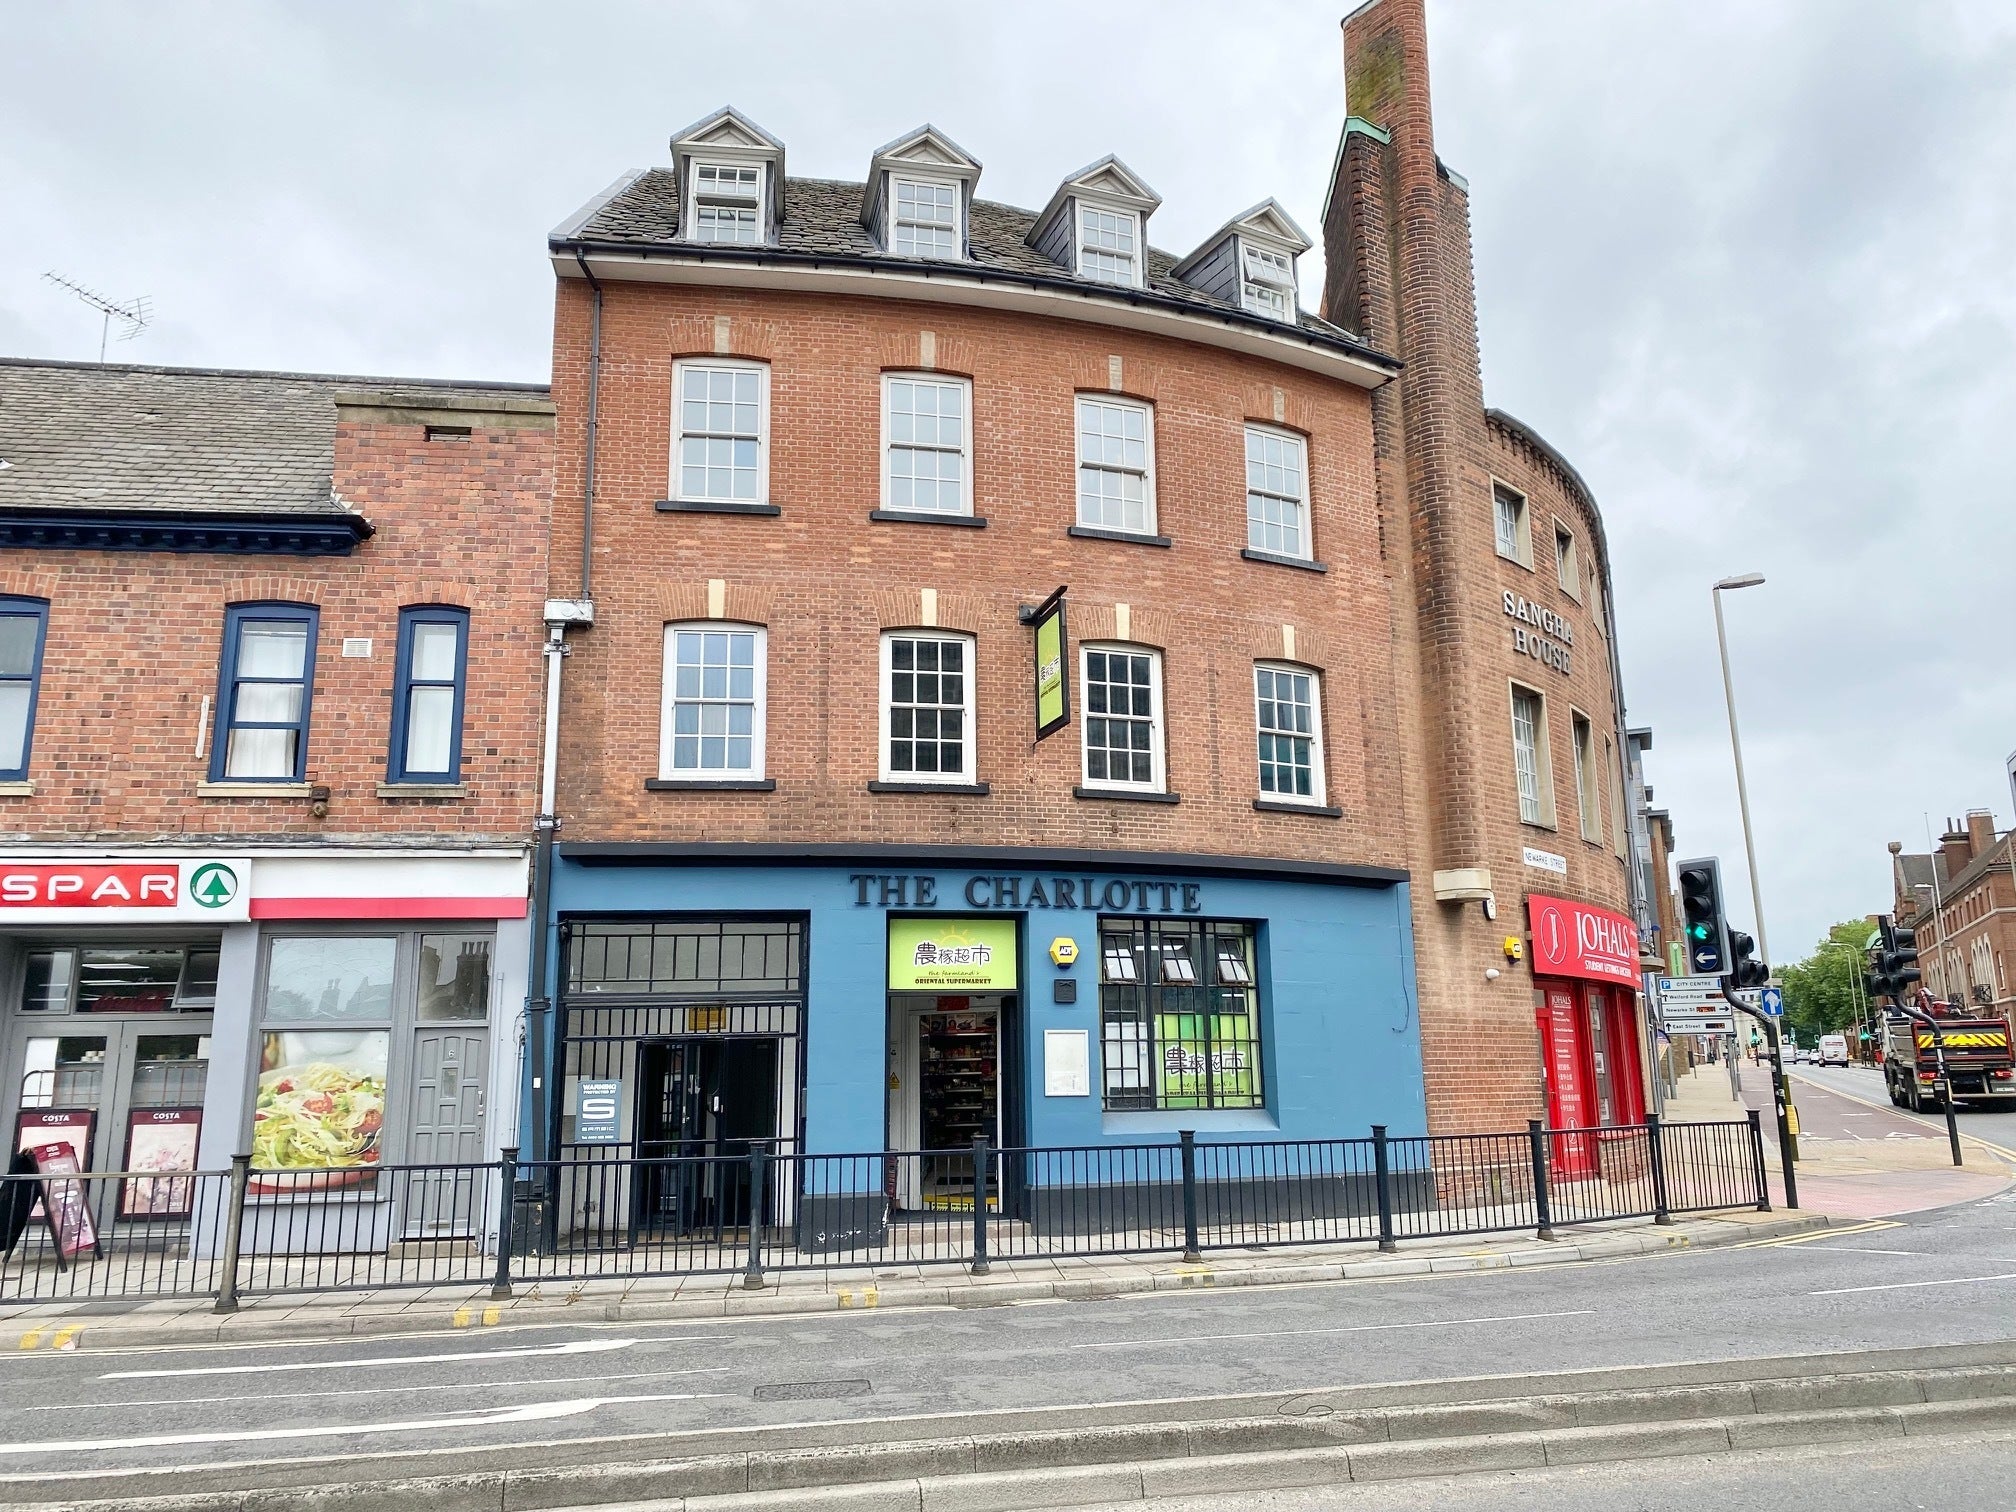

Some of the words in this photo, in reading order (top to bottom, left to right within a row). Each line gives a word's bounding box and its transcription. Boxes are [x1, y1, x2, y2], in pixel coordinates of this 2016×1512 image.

[1502, 590, 1573, 647] SANGHA
[1512, 626, 1571, 675] HOUSE
[1525, 852, 1548, 865] NEWARKE
[1550, 857, 1565, 869] STREET
[2, 874, 176, 901] SPAR
[850, 874, 938, 906] THE
[964, 875, 1202, 912] CHARLOTTE
[1574, 911, 1630, 959] JOHALS
[915, 941, 991, 965] 農稼超市
[1552, 995, 1571, 1004] JOHALS
[449, 1050, 455, 1059] 6
[153, 1112, 180, 1120] COSTA
[582, 1098, 615, 1119] S
